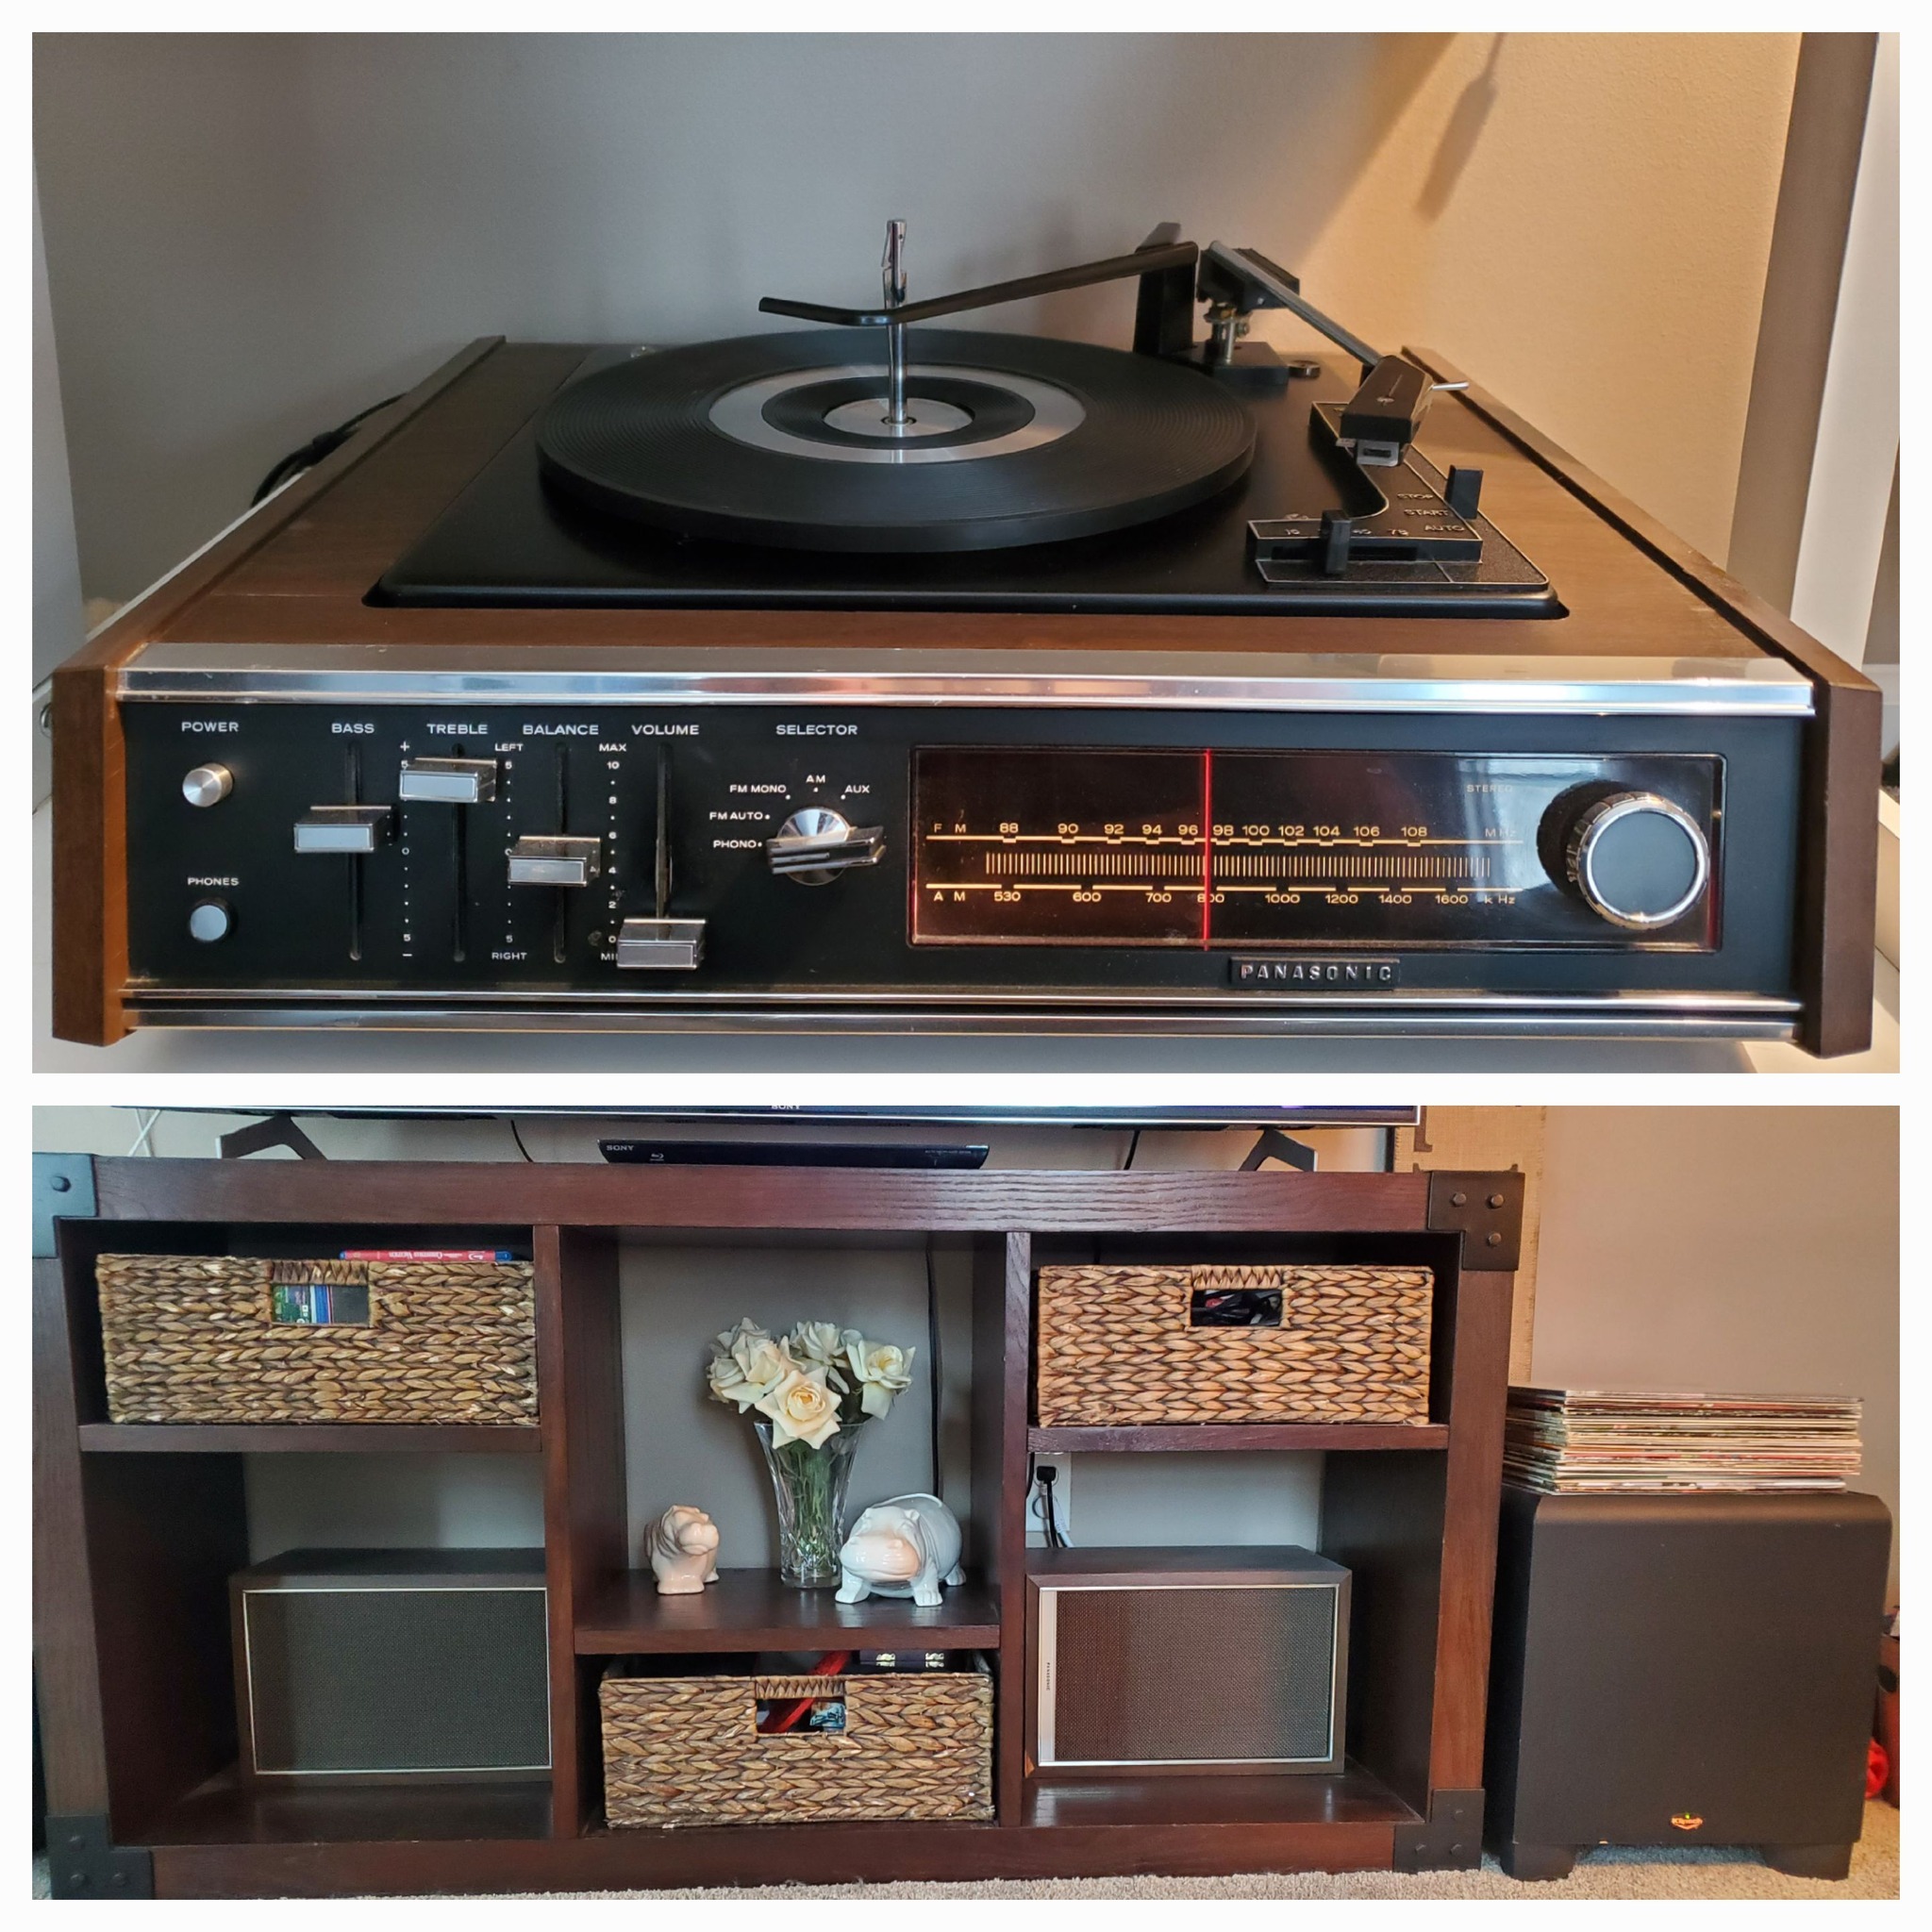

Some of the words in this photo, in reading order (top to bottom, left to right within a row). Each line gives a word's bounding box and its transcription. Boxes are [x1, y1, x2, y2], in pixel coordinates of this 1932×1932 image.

[1405, 508, 1449, 517] START
[1424, 524, 1465, 532] AUTO
[181, 721, 240, 733] POWER
[331, 723, 375, 734] BASS
[426, 723, 489, 735] TREBLE
[523, 724, 599, 736] BALANCE
[631, 724, 700, 736] VOLUME
[775, 724, 858, 736] SELECTOR
[494, 742, 524, 752] LEFT
[598, 742, 627, 752] MAX
[505, 760, 513, 770] 5
[607, 760, 621, 770] 10
[806, 774, 826, 783] AM
[729, 784, 748, 793] FM
[750, 784, 787, 793] MONO
[844, 784, 870, 793] AUX
[1466, 784, 1513, 793] STEREO
[608, 795, 617, 805] 8
[708, 811, 728, 821] FM
[729, 811, 764, 821] AUTO
[999, 822, 1019, 834] 88
[1058, 823, 1079, 835] 90
[1104, 824, 1124, 835] 92
[1141, 824, 1163, 835] 94
[1177, 824, 1199, 836] 96
[1212, 824, 1235, 837] 98
[1241, 824, 1271, 837] 100
[1277, 824, 1305, 837] 102
[1312, 825, 1341, 837] 104
[1353, 825, 1380, 838] 106
[1401, 826, 1428, 838] 108
[608, 831, 617, 840] 6
[712, 840, 757, 849] PHONO
[608, 866, 617, 874] 4
[187, 876, 240, 887] PHONES
[993, 891, 1022, 902] 530
[1072, 891, 1102, 903] 600
[1145, 891, 1173, 903] 700
[1264, 893, 1301, 904] 1000
[1324, 893, 1359, 905] 1200
[1378, 893, 1412, 905] 1400
[1435, 893, 1469, 905] 1600
[608, 900, 617, 909] 2
[403, 933, 411, 942] 5
[506, 934, 513, 943] 5
[491, 952, 527, 960] RIGHT
[1241, 965, 1391, 980] PANASONIC
